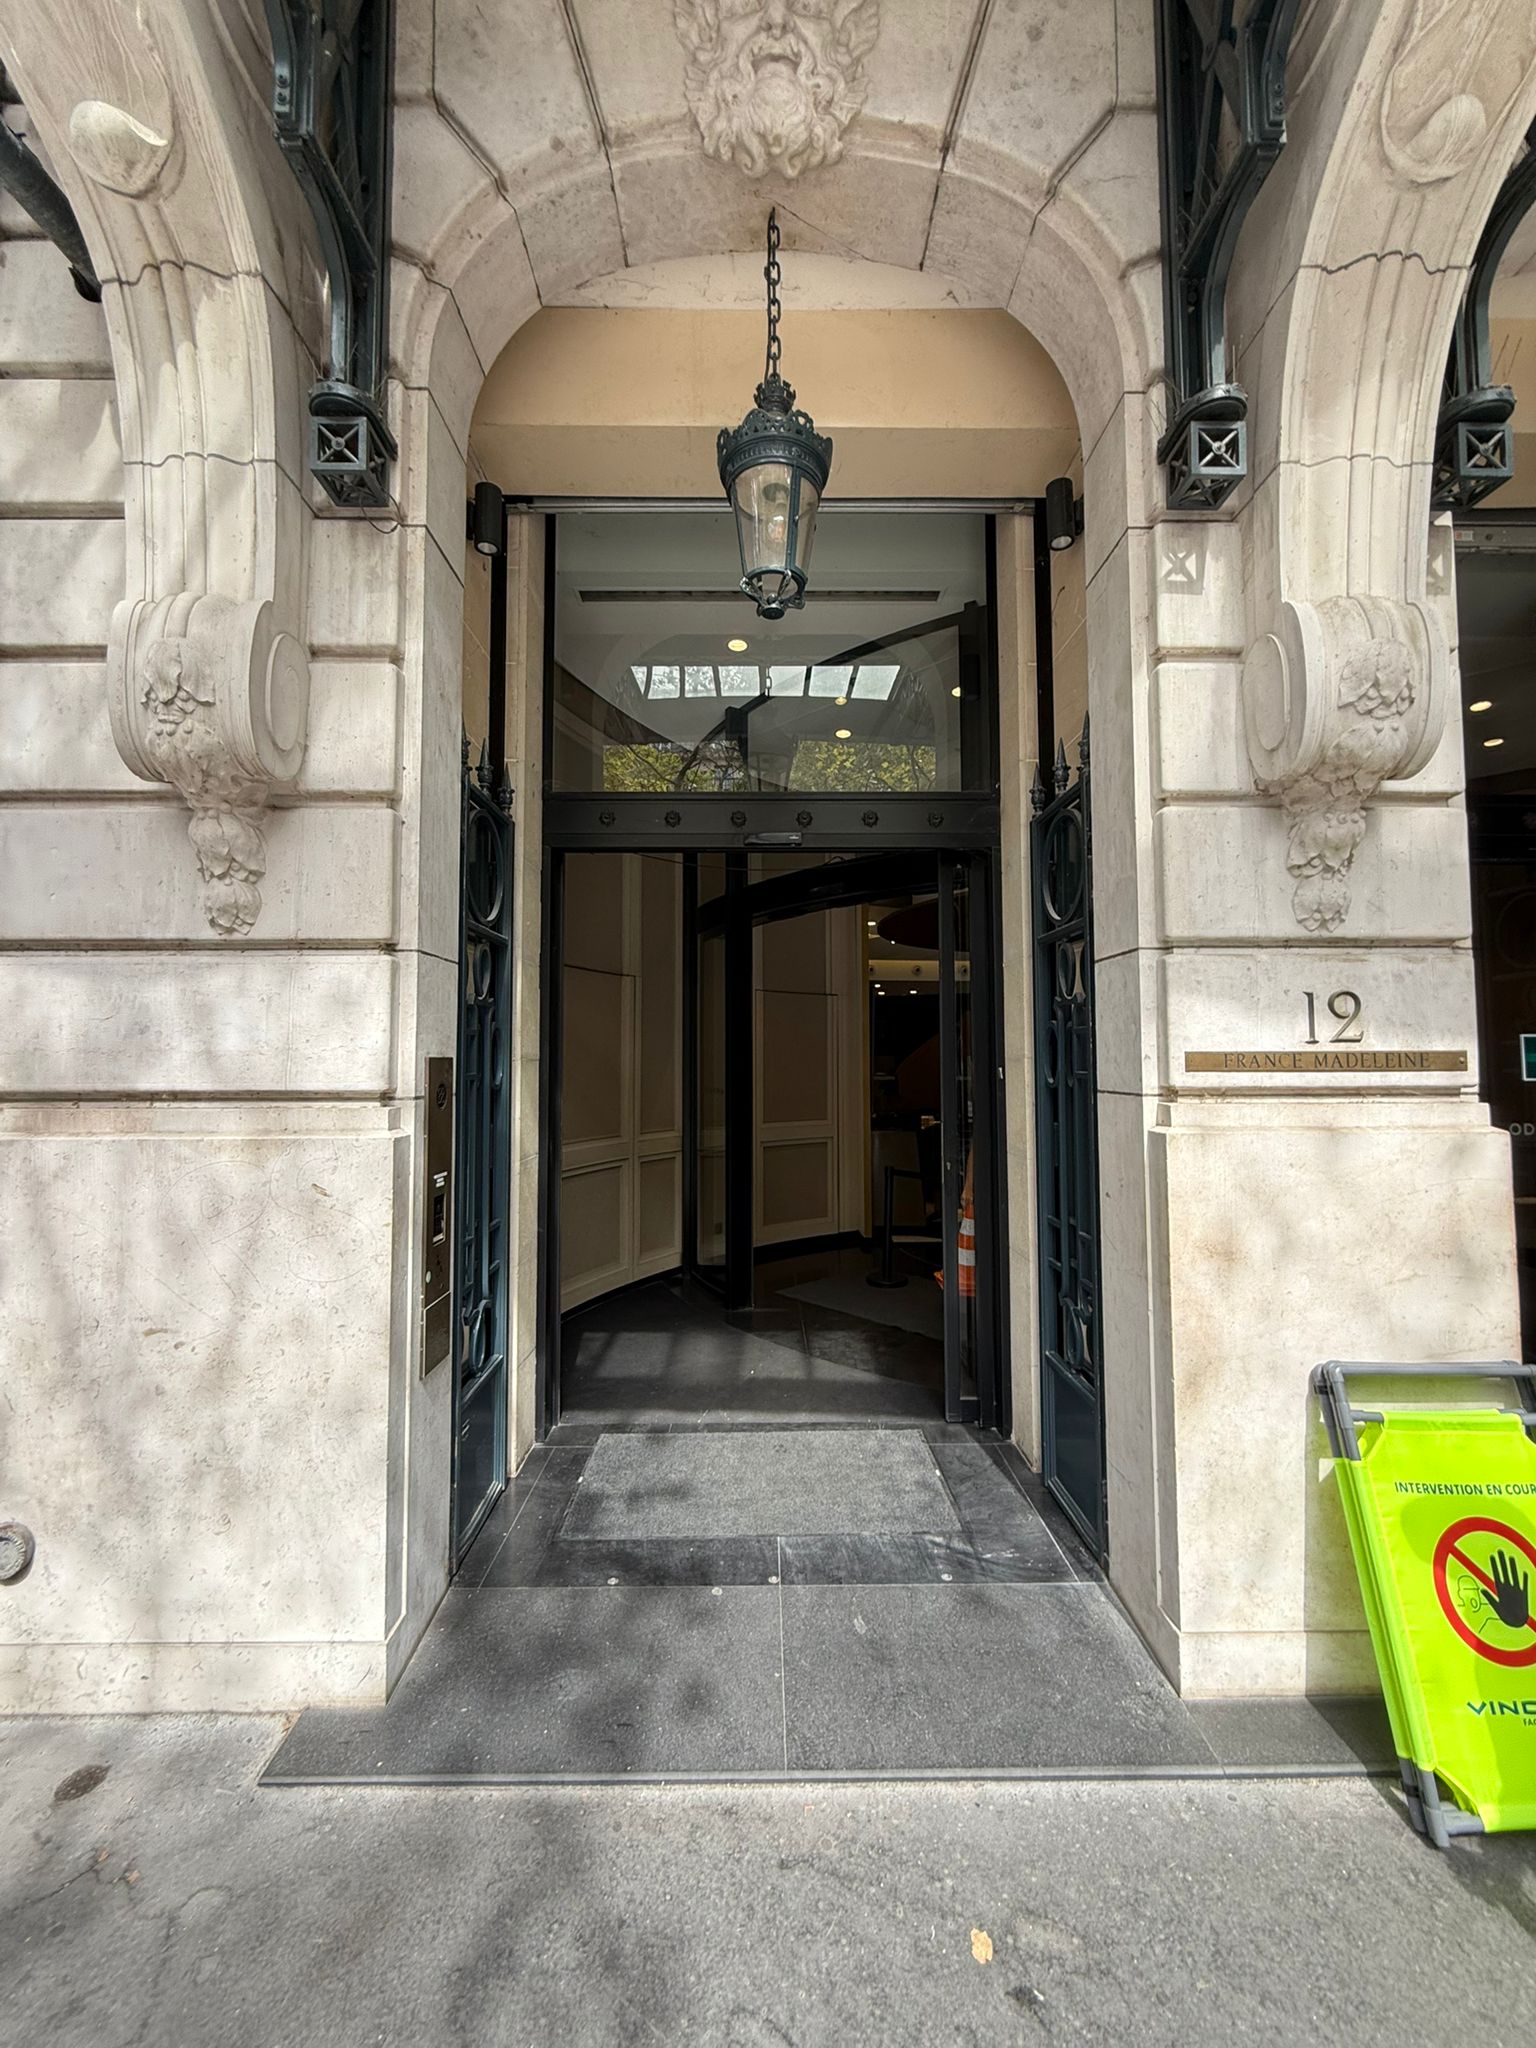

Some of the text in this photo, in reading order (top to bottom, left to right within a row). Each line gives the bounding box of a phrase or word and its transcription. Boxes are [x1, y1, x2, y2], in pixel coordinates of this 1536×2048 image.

[1302, 990, 1365, 1044] 12
[1223, 1052, 1431, 1069] FRANCE MADELEINE
[1395, 1482, 1536, 1495] INTERVENTION EN COUR
